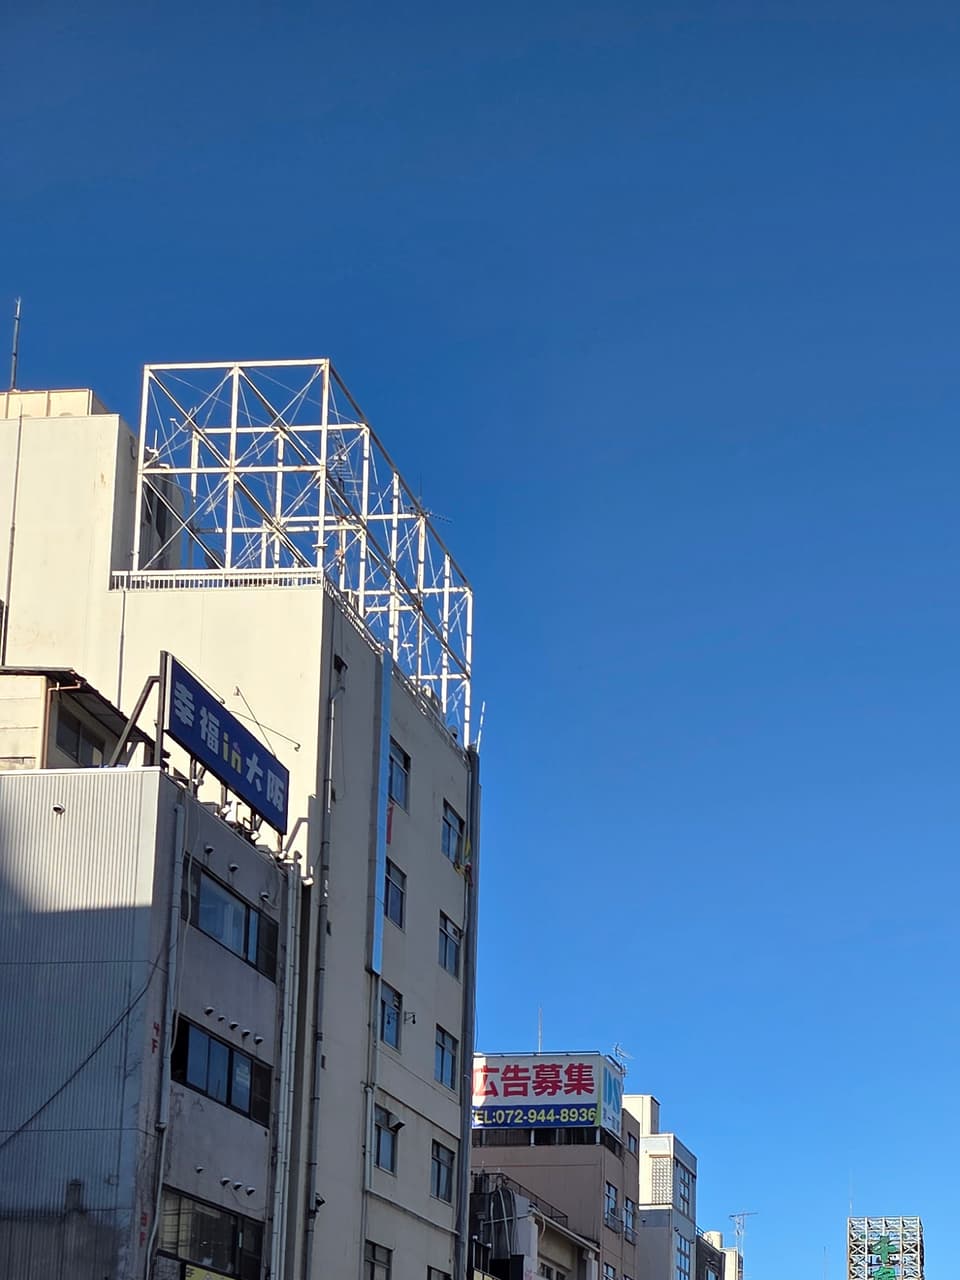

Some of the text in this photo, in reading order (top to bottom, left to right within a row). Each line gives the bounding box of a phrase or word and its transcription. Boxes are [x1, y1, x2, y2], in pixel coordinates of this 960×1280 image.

[174, 681, 285, 812] 幸福in大阪
[472, 1063, 595, 1097] 広告募集
